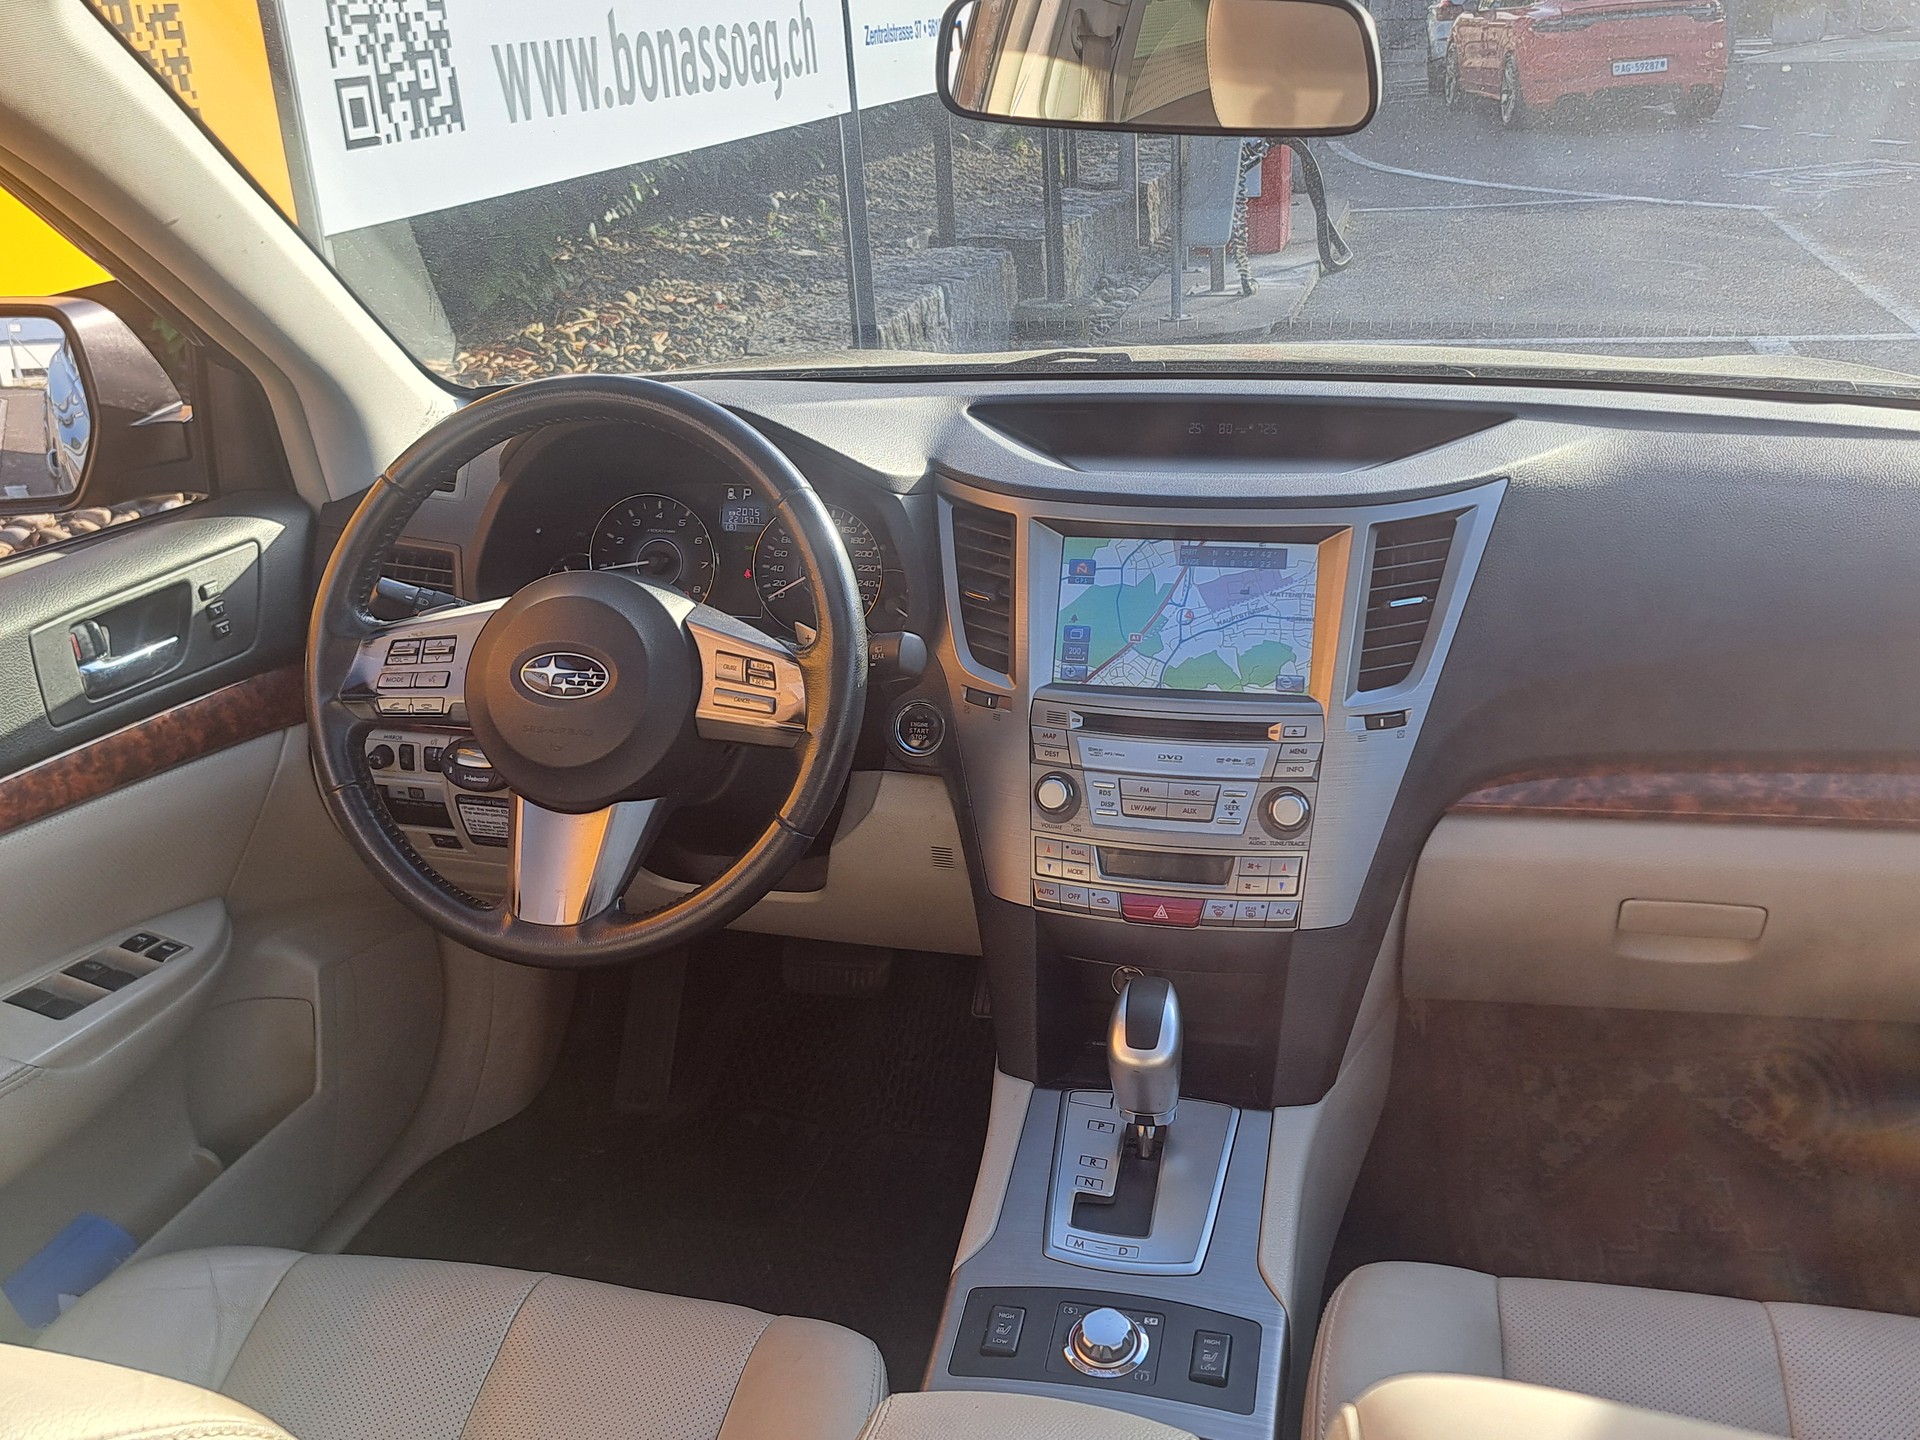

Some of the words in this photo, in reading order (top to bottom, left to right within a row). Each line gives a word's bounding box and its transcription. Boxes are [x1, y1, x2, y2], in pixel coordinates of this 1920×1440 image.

[864, 23, 913, 46] Zentralstrasse
[914, 20, 921, 38] 37
[928, 18, 941, 37] 561
[491, 2, 818, 123] www.bonassoag.ch
[742, 488, 752, 500] P
[841, 526, 857, 534] 160
[616, 537, 625, 545] 2
[850, 536, 866, 544] 180
[773, 549, 788, 557] 60
[855, 550, 874, 558] 200
[701, 561, 709, 569] 7
[857, 564, 877, 572] 220
[858, 579, 876, 587] 240
[1069, 647, 1082, 655] 200
[722, 663, 738, 671] CRUISE
[1157, 753, 1184, 761] DVD
[1184, 789, 1201, 797] DISC
[1182, 807, 1197, 815] AUX
[1040, 822, 1063, 830] VOLUME
[1070, 848, 1085, 856] DUAL
[1067, 868, 1084, 876] MODE
[1037, 888, 1055, 896] AUTO
[1089, 1158, 1097, 1166] R
[1084, 1179, 1094, 1187] N
[1073, 1240, 1085, 1249] M
[1118, 1247, 1128, 1255] D
[998, 1312, 1015, 1320] HIGH
[1203, 1338, 1221, 1346] HIGH
